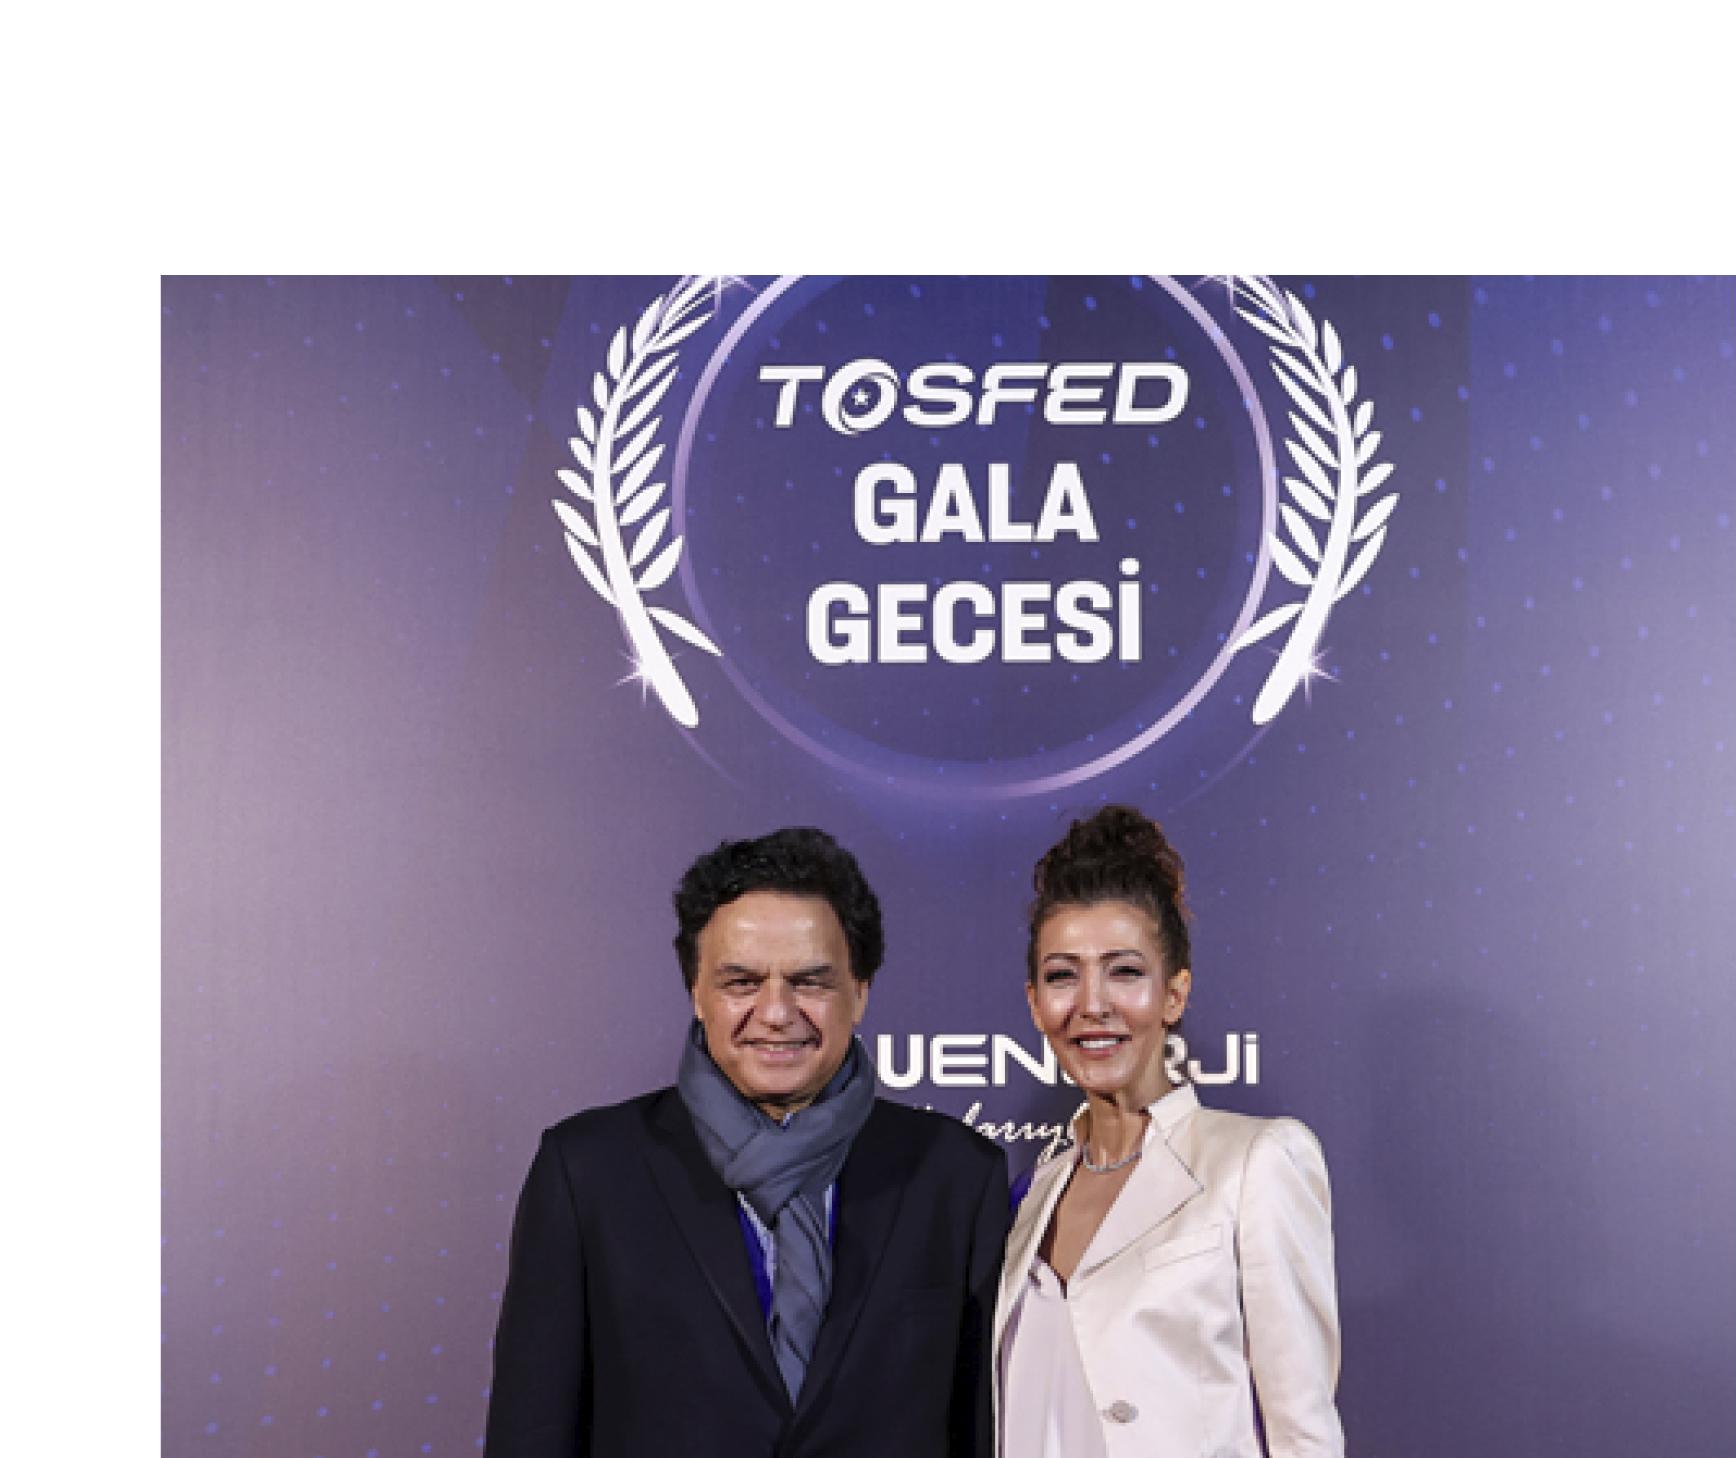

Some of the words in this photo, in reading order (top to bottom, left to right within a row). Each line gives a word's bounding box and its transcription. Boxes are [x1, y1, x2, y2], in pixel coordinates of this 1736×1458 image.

[758, 358, 1190, 435] TOSFED
[853, 462, 1100, 545] GALA
[807, 557, 1142, 664] GECESİ
